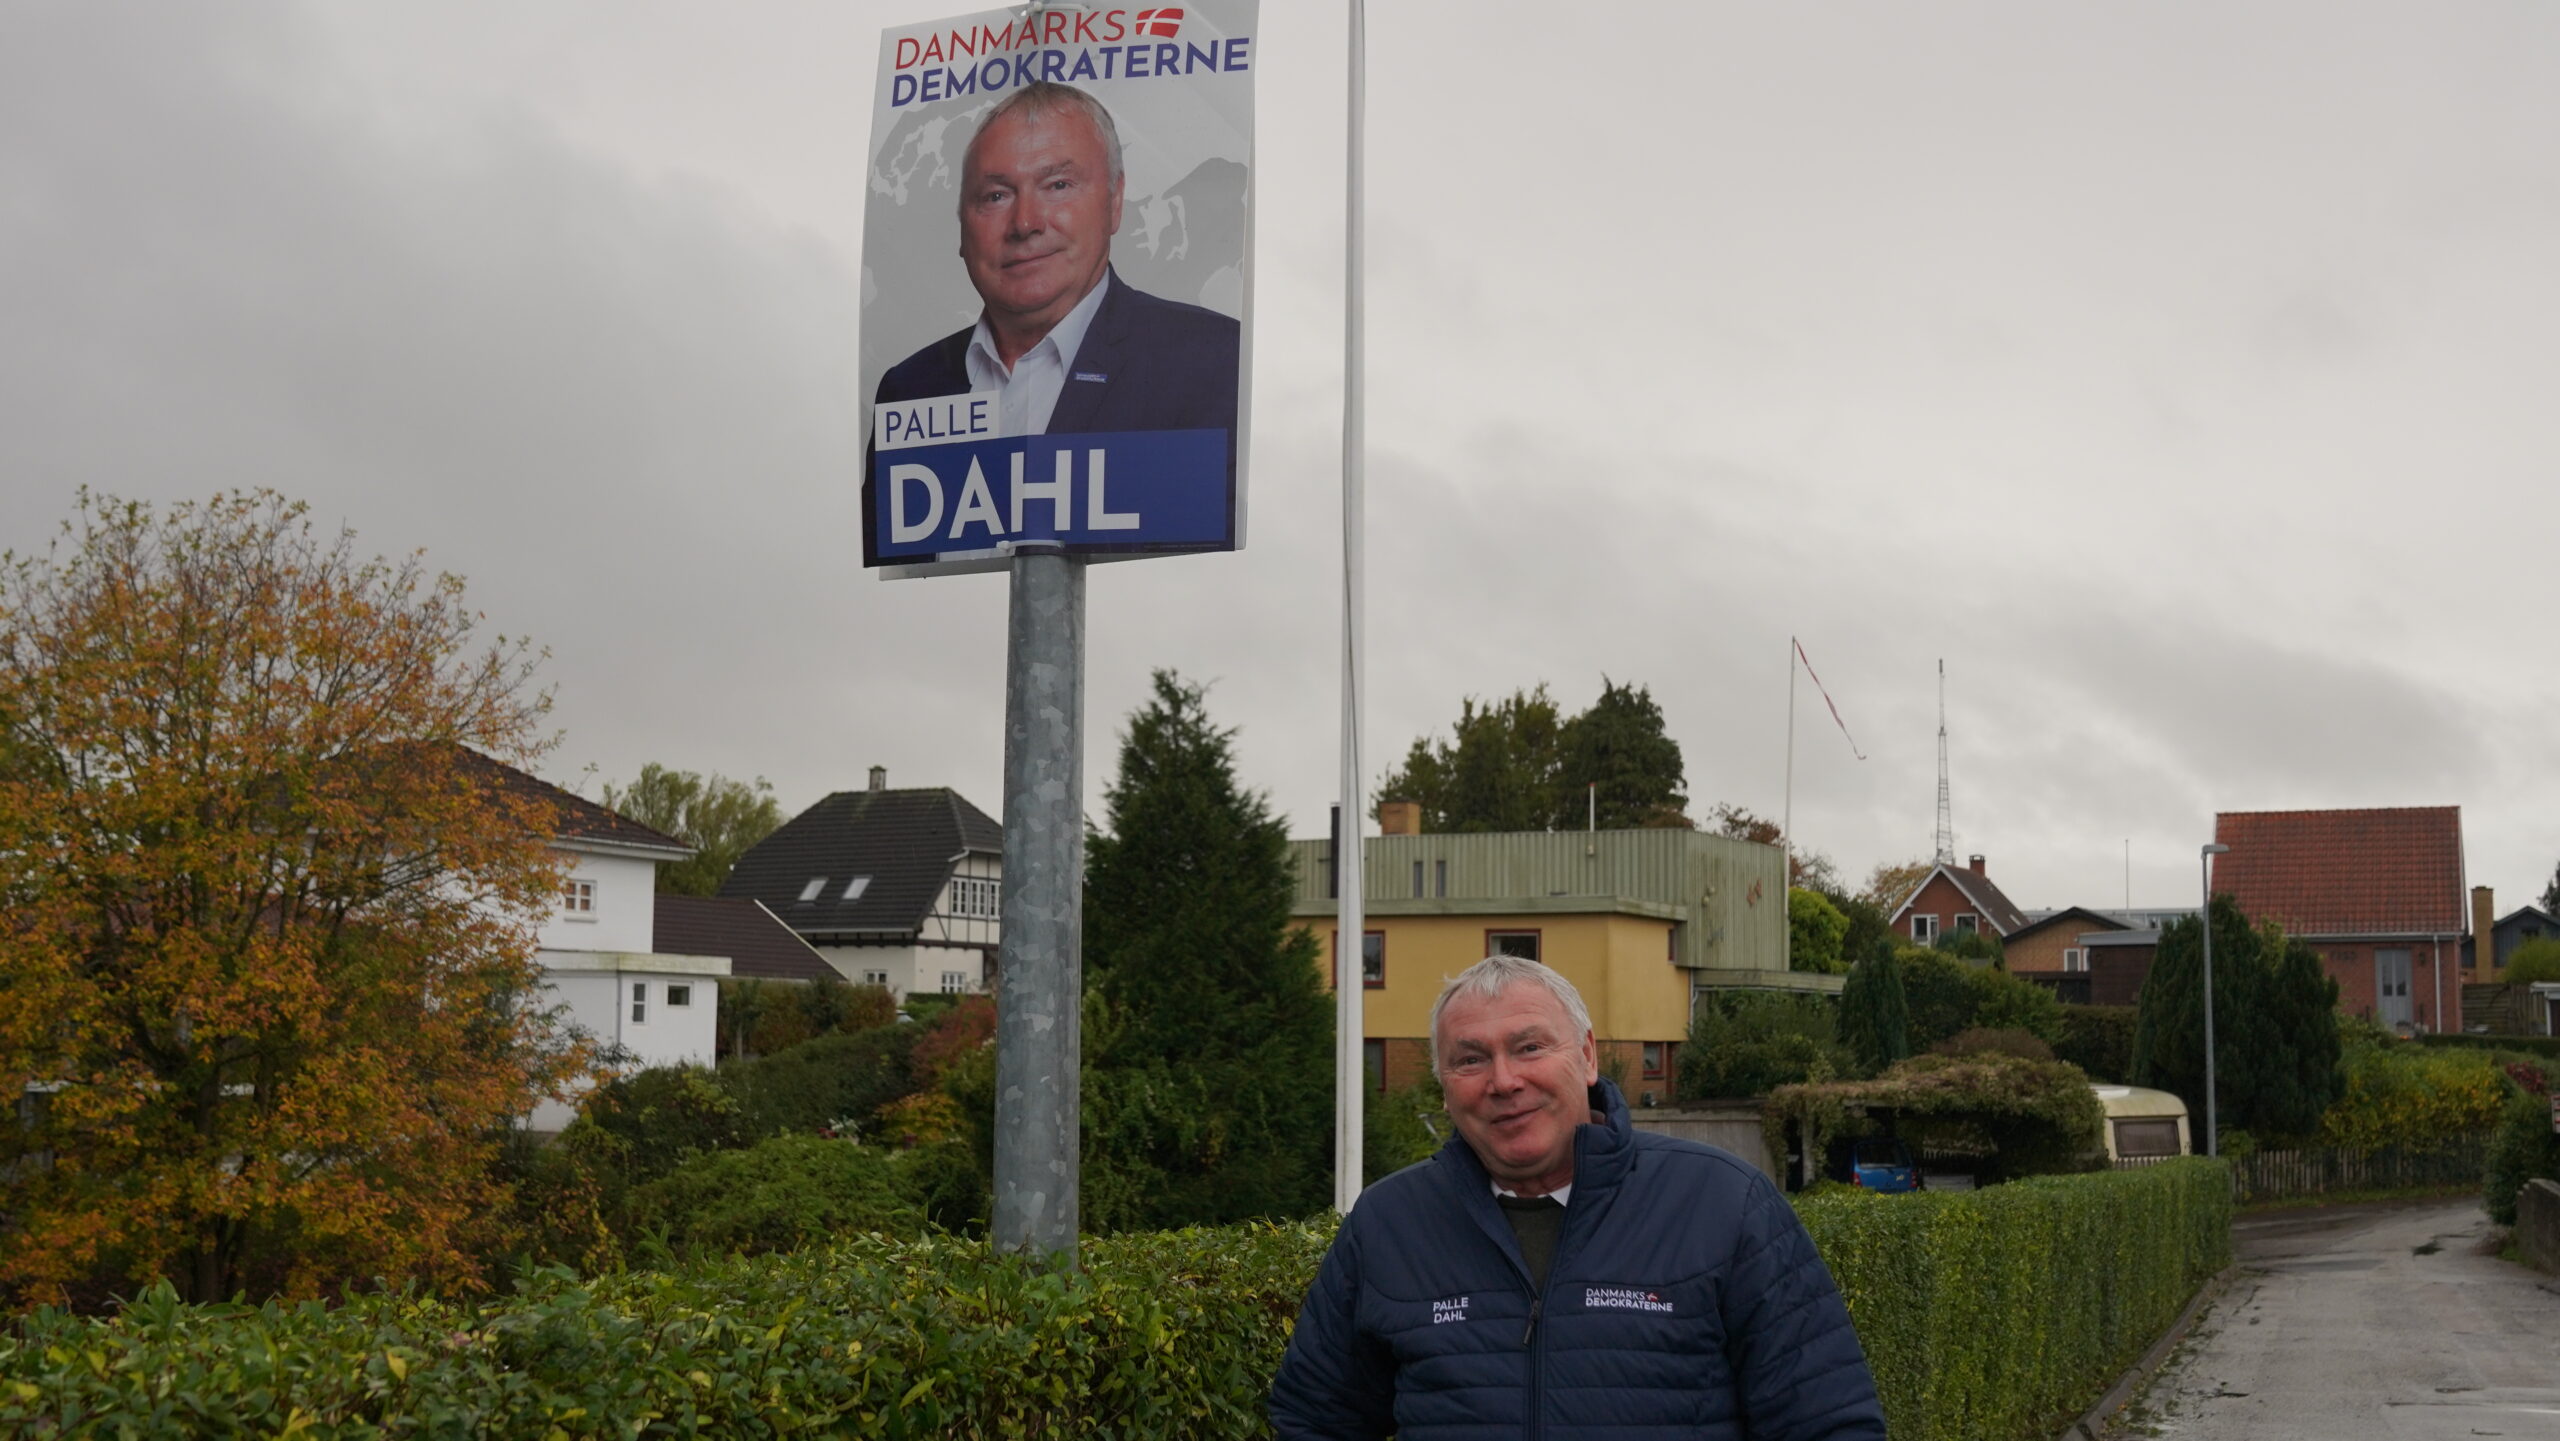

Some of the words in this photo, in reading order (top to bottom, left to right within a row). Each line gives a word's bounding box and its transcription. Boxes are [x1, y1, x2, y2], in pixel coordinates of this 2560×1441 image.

[895, 9, 1126, 70] DANMARKS
[892, 38, 1250, 107] DEMOKRATERNE
[886, 401, 988, 443] PALLE
[890, 448, 1140, 544] DAHL
[1433, 1297, 1469, 1312] PALLE
[1586, 1288, 1645, 1301] DANMARKS
[1586, 1297, 1673, 1312] DEMOKRATERNE
[1434, 1310, 1466, 1324] DAHL
